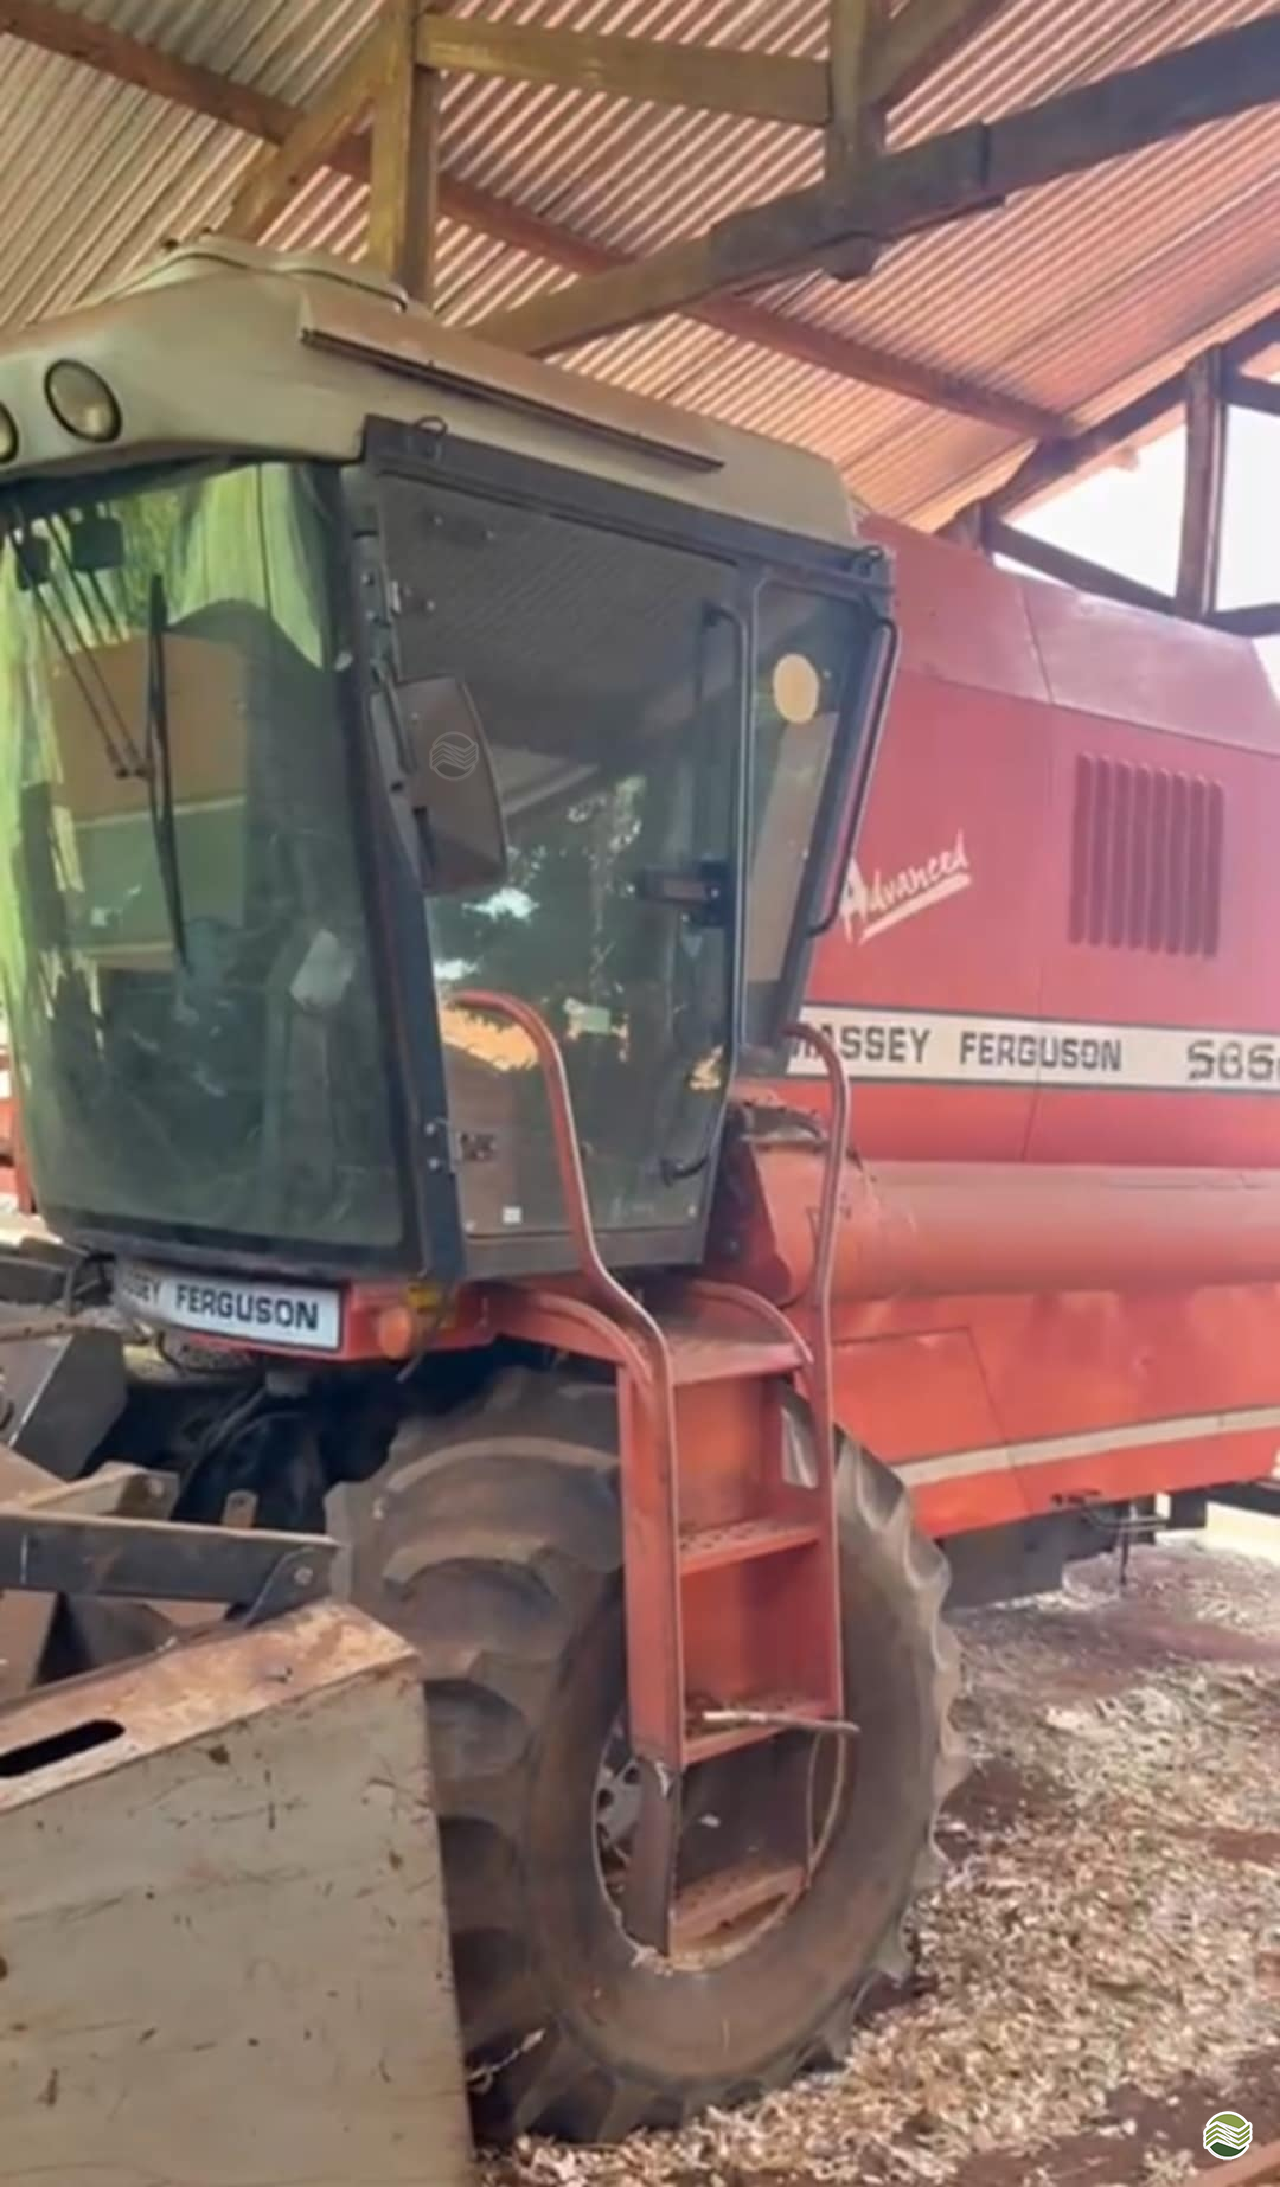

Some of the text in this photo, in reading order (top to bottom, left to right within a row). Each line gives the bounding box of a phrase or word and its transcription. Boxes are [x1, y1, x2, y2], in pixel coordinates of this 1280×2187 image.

[840, 828, 969, 943] Advanced
[960, 1031, 1121, 1071] FERGUSON
[175, 1283, 319, 1331] FERGUSON
